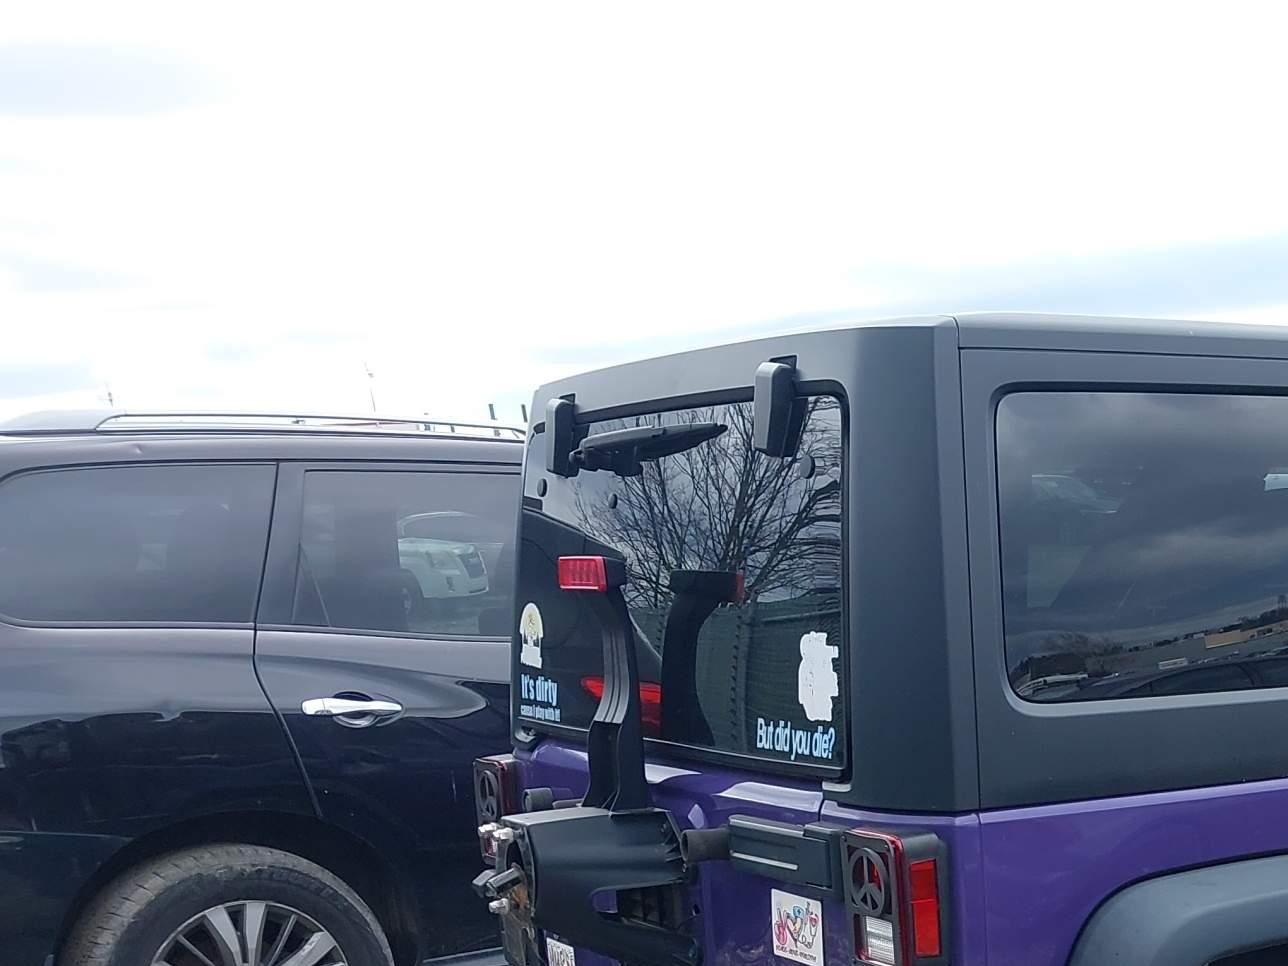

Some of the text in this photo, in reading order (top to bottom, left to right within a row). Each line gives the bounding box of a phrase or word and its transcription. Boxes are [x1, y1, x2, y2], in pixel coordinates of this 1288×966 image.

[521, 673, 557, 707] It's dirty
[756, 717, 835, 761] But did you die?
